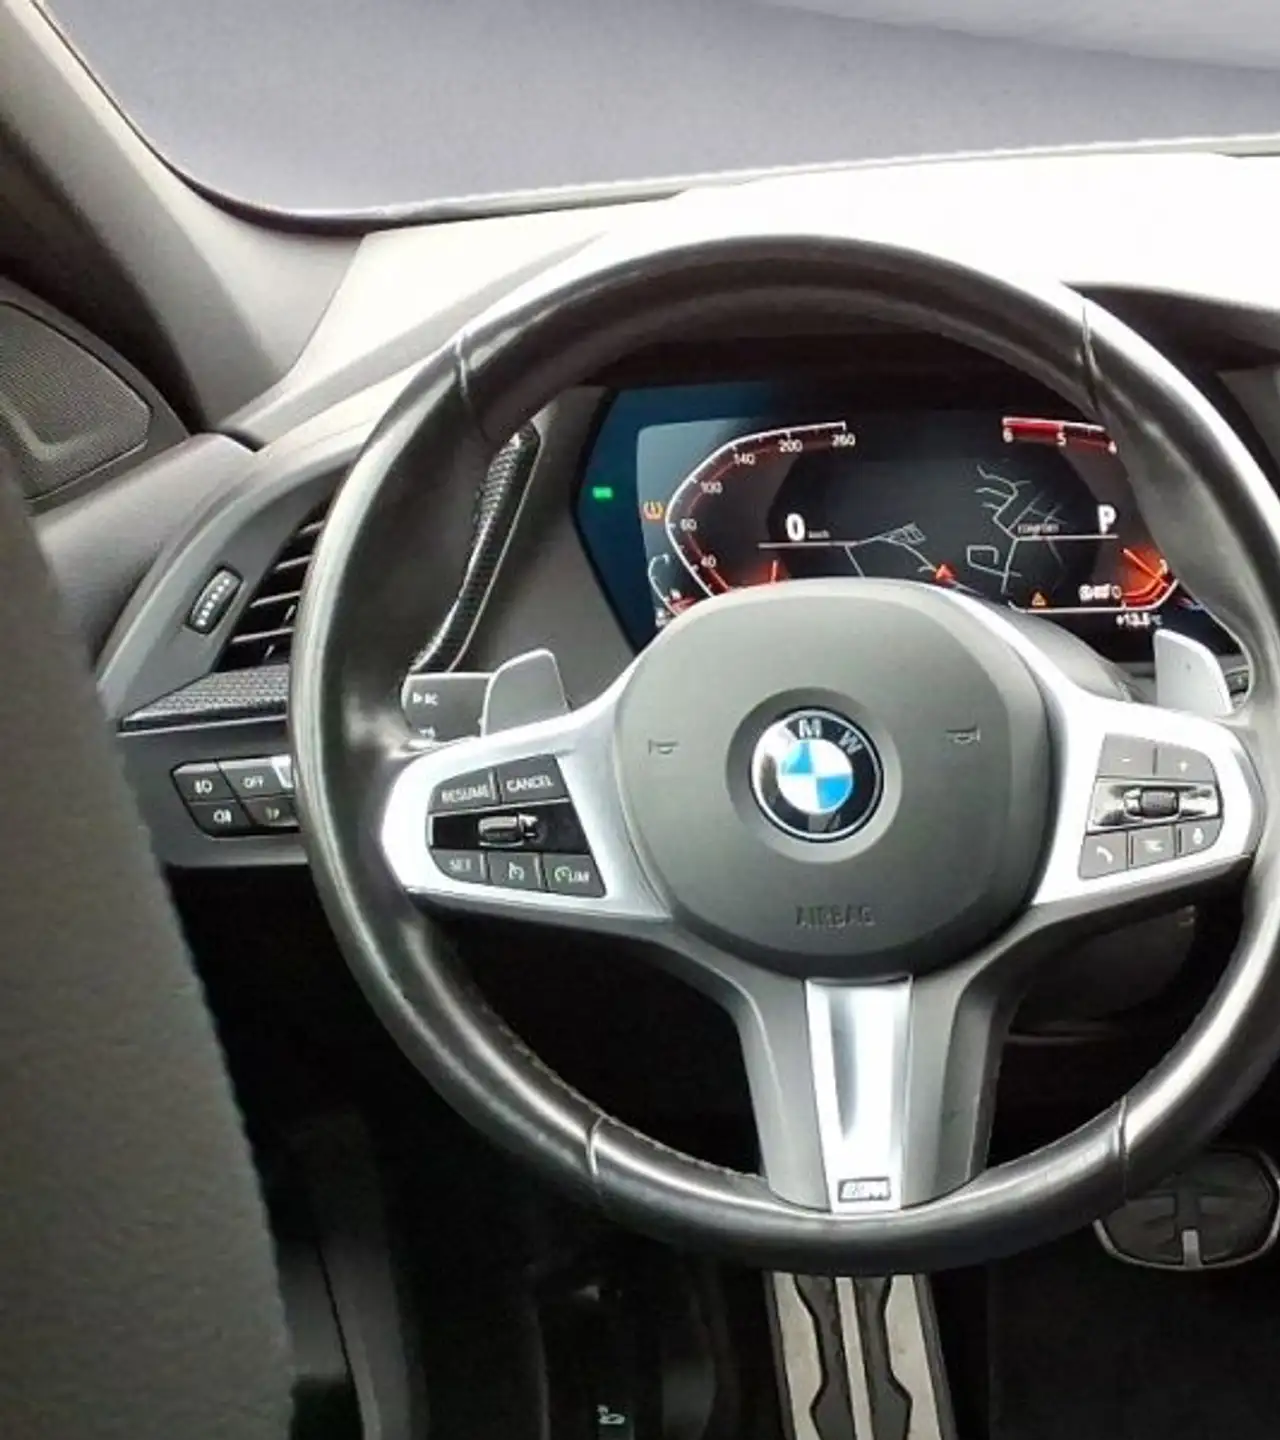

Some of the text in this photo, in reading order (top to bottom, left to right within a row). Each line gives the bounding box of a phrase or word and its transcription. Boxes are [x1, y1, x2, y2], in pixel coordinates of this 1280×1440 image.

[777, 439, 803, 452] 200
[1056, 431, 1067, 446] 5
[733, 453, 756, 466] 140
[700, 481, 723, 494] 100
[785, 513, 805, 541] 0
[1097, 504, 1118, 535] P
[243, 776, 264, 789] OFF
[506, 775, 554, 792] CANCEL
[441, 785, 490, 803] RESUME
